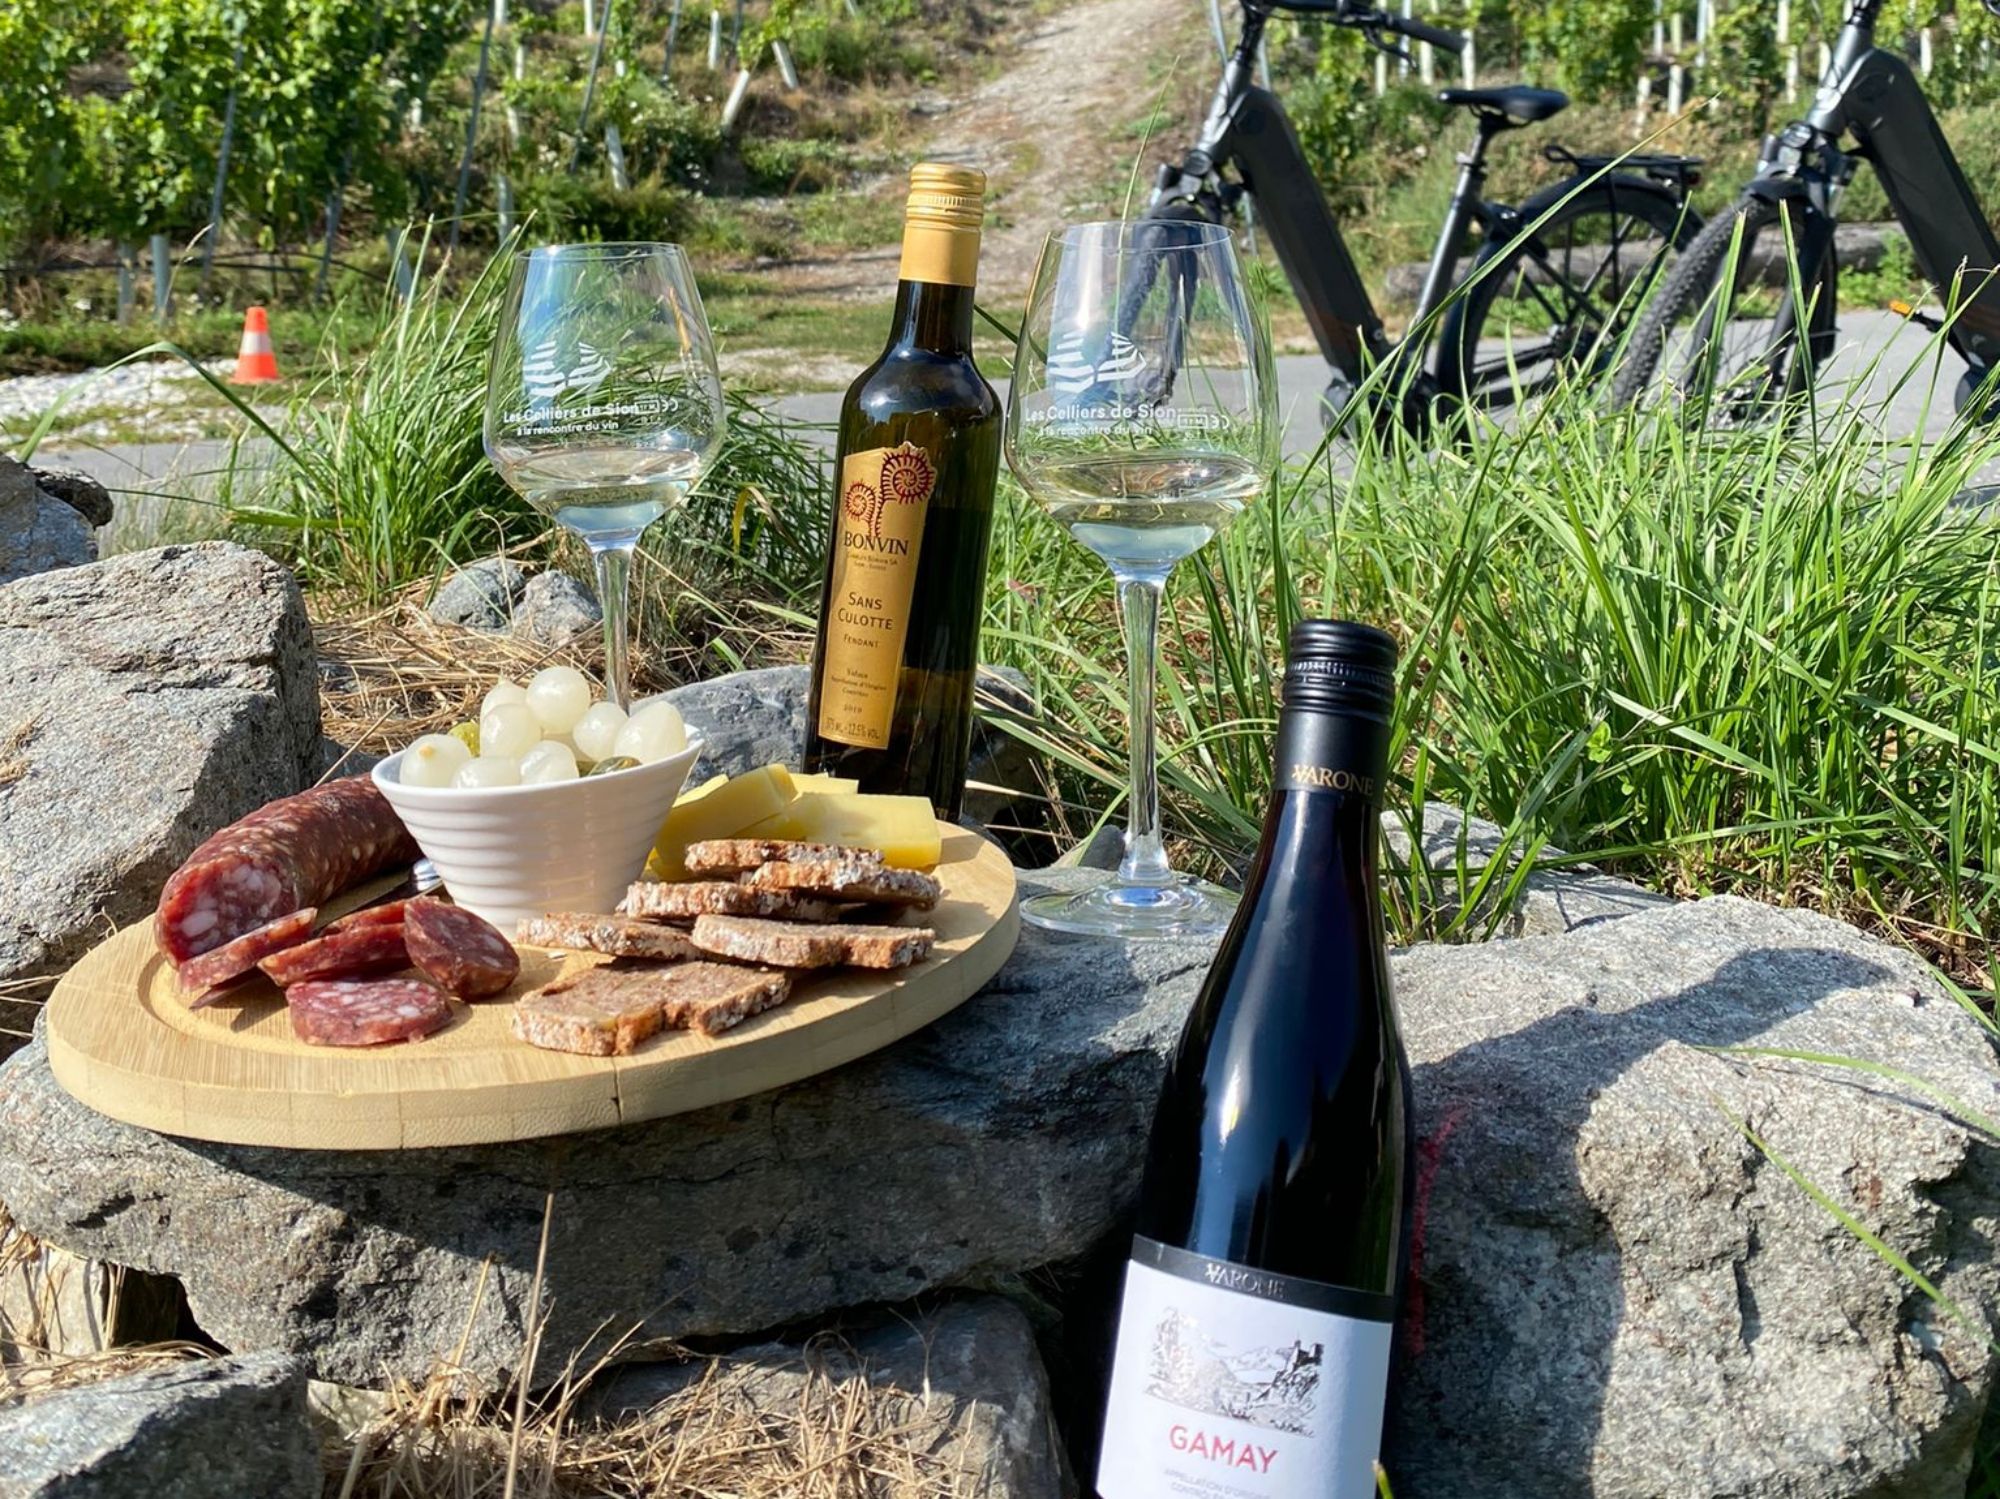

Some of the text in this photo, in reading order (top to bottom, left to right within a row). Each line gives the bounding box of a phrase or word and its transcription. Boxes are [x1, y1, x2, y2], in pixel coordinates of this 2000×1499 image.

[503, 410, 521, 423] Les
[523, 406, 577, 421] Celliers
[582, 404, 601, 418] de
[604, 402, 639, 415] Sion
[1025, 403, 1177, 422] Les Celliers de Sion
[533, 423, 582, 435] rencontre
[585, 421, 599, 431] du
[602, 420, 619, 430] vin
[1057, 425, 1111, 436] rencontre
[1114, 425, 1130, 435] du
[844, 530, 909, 556] BONVIN
[848, 591, 883, 611] SANS
[837, 607, 894, 631] CULOTTE
[1291, 763, 1375, 796] VARONE
[1168, 1424, 1279, 1474] GAMAY
